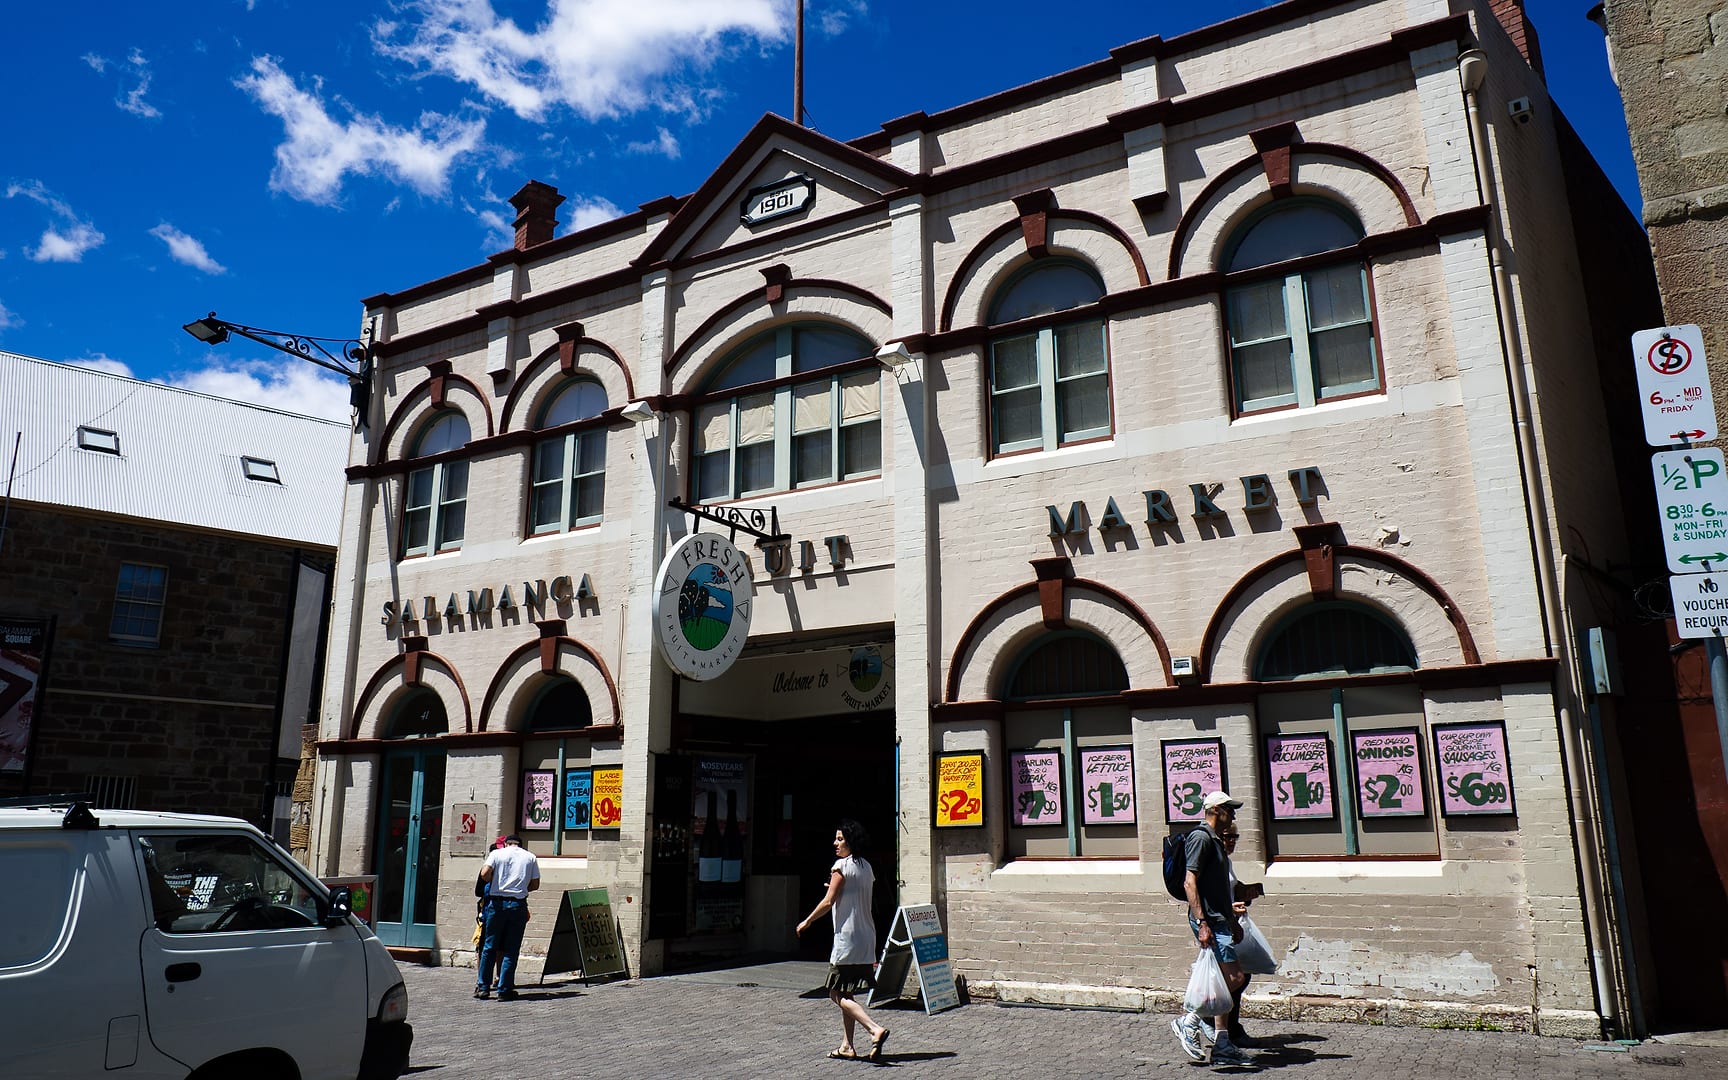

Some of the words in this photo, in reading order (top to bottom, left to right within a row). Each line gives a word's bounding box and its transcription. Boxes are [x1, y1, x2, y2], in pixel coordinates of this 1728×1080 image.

[760, 193, 793, 214] 1901
[1683, 386, 1702, 397] MID
[1660, 404, 1694, 414] FRIDAY
[1672, 532, 1680, 541] &
[1683, 530, 1727, 541] SUNDAY
[381, 573, 596, 625] SALAMANCA
[1046, 466, 1322, 538] MARKET
[681, 540, 745, 585] FRESH
[1698, 582, 1719, 594] NO
[5, 634, 32, 644] SQUARE
[772, 671, 815, 693] Welcome
[818, 668, 829, 689] to
[841, 690, 862, 710] FRUIT
[865, 681, 892, 711] MARKET
[1363, 739, 1383, 747] RED
[1451, 738, 1485, 746] RECIPE
[1167, 747, 1218, 758] NECTARINES
[1272, 750, 1325, 762] CUCUMBER
[1358, 745, 1415, 759] ONIONS
[1442, 750, 1497, 764] SAUSAGES
[1017, 758, 1053, 767] YEARLING
[1087, 762, 1131, 774] LETTUCE
[1169, 760, 1214, 771] PEACHES
[1486, 761, 1502, 772] KG
[1397, 763, 1413, 774] KG
[1018, 774, 1047, 784] STEAK
[528, 786, 548, 795] CHOPS
[566, 787, 591, 797] STEA
[594, 785, 622, 794] CHERRIES
[1045, 781, 1058, 792] KG
[194, 876, 218, 889] THE
[187, 902, 208, 910] SHOP
[907, 909, 937, 922] Salamanca
[581, 919, 611, 935] SUSHI
[583, 933, 615, 949] ROLLS
